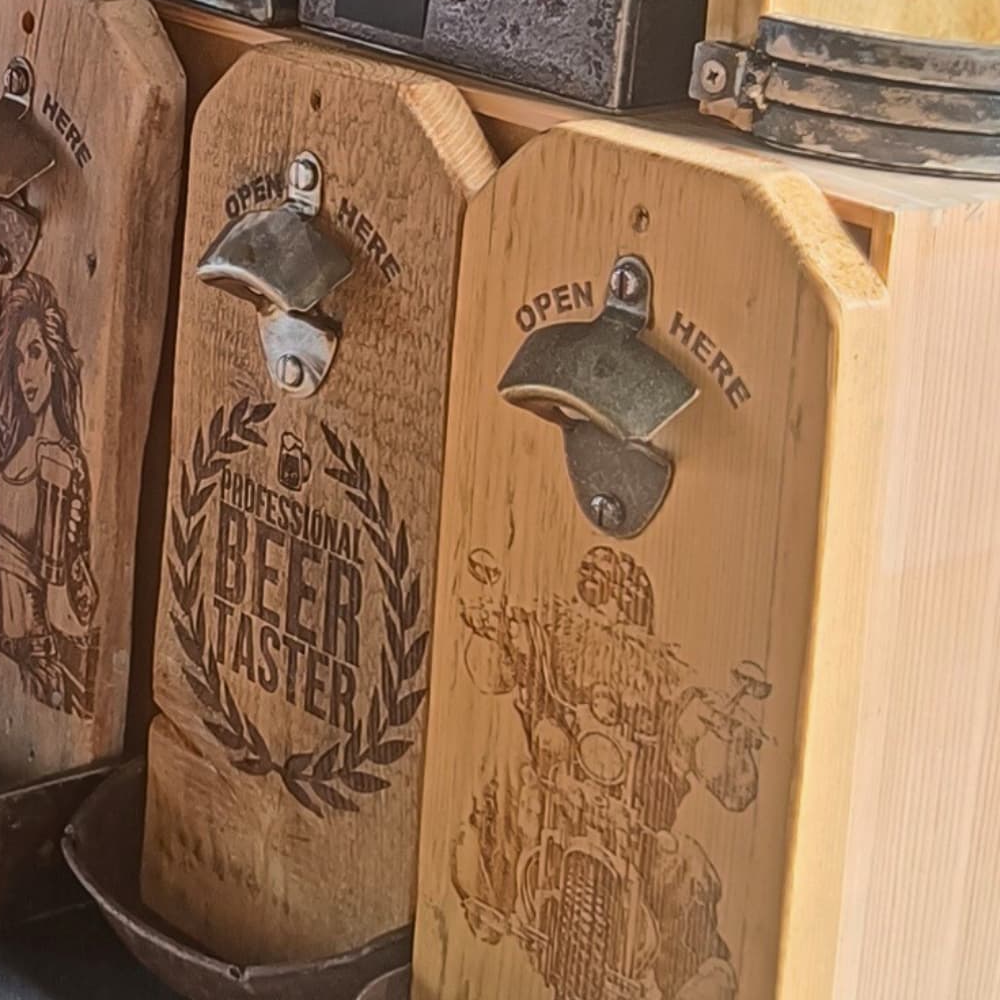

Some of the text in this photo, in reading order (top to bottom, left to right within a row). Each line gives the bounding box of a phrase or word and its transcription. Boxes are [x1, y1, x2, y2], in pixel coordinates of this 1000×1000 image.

[42, 93, 92, 169] HERE
[224, 172, 401, 283] OPEN HERE
[515, 280, 752, 409] OPEN HERE
[220, 468, 364, 565] PROFESSIONAL
[214, 500, 364, 668] BEER
[213, 597, 357, 733] TASTER
